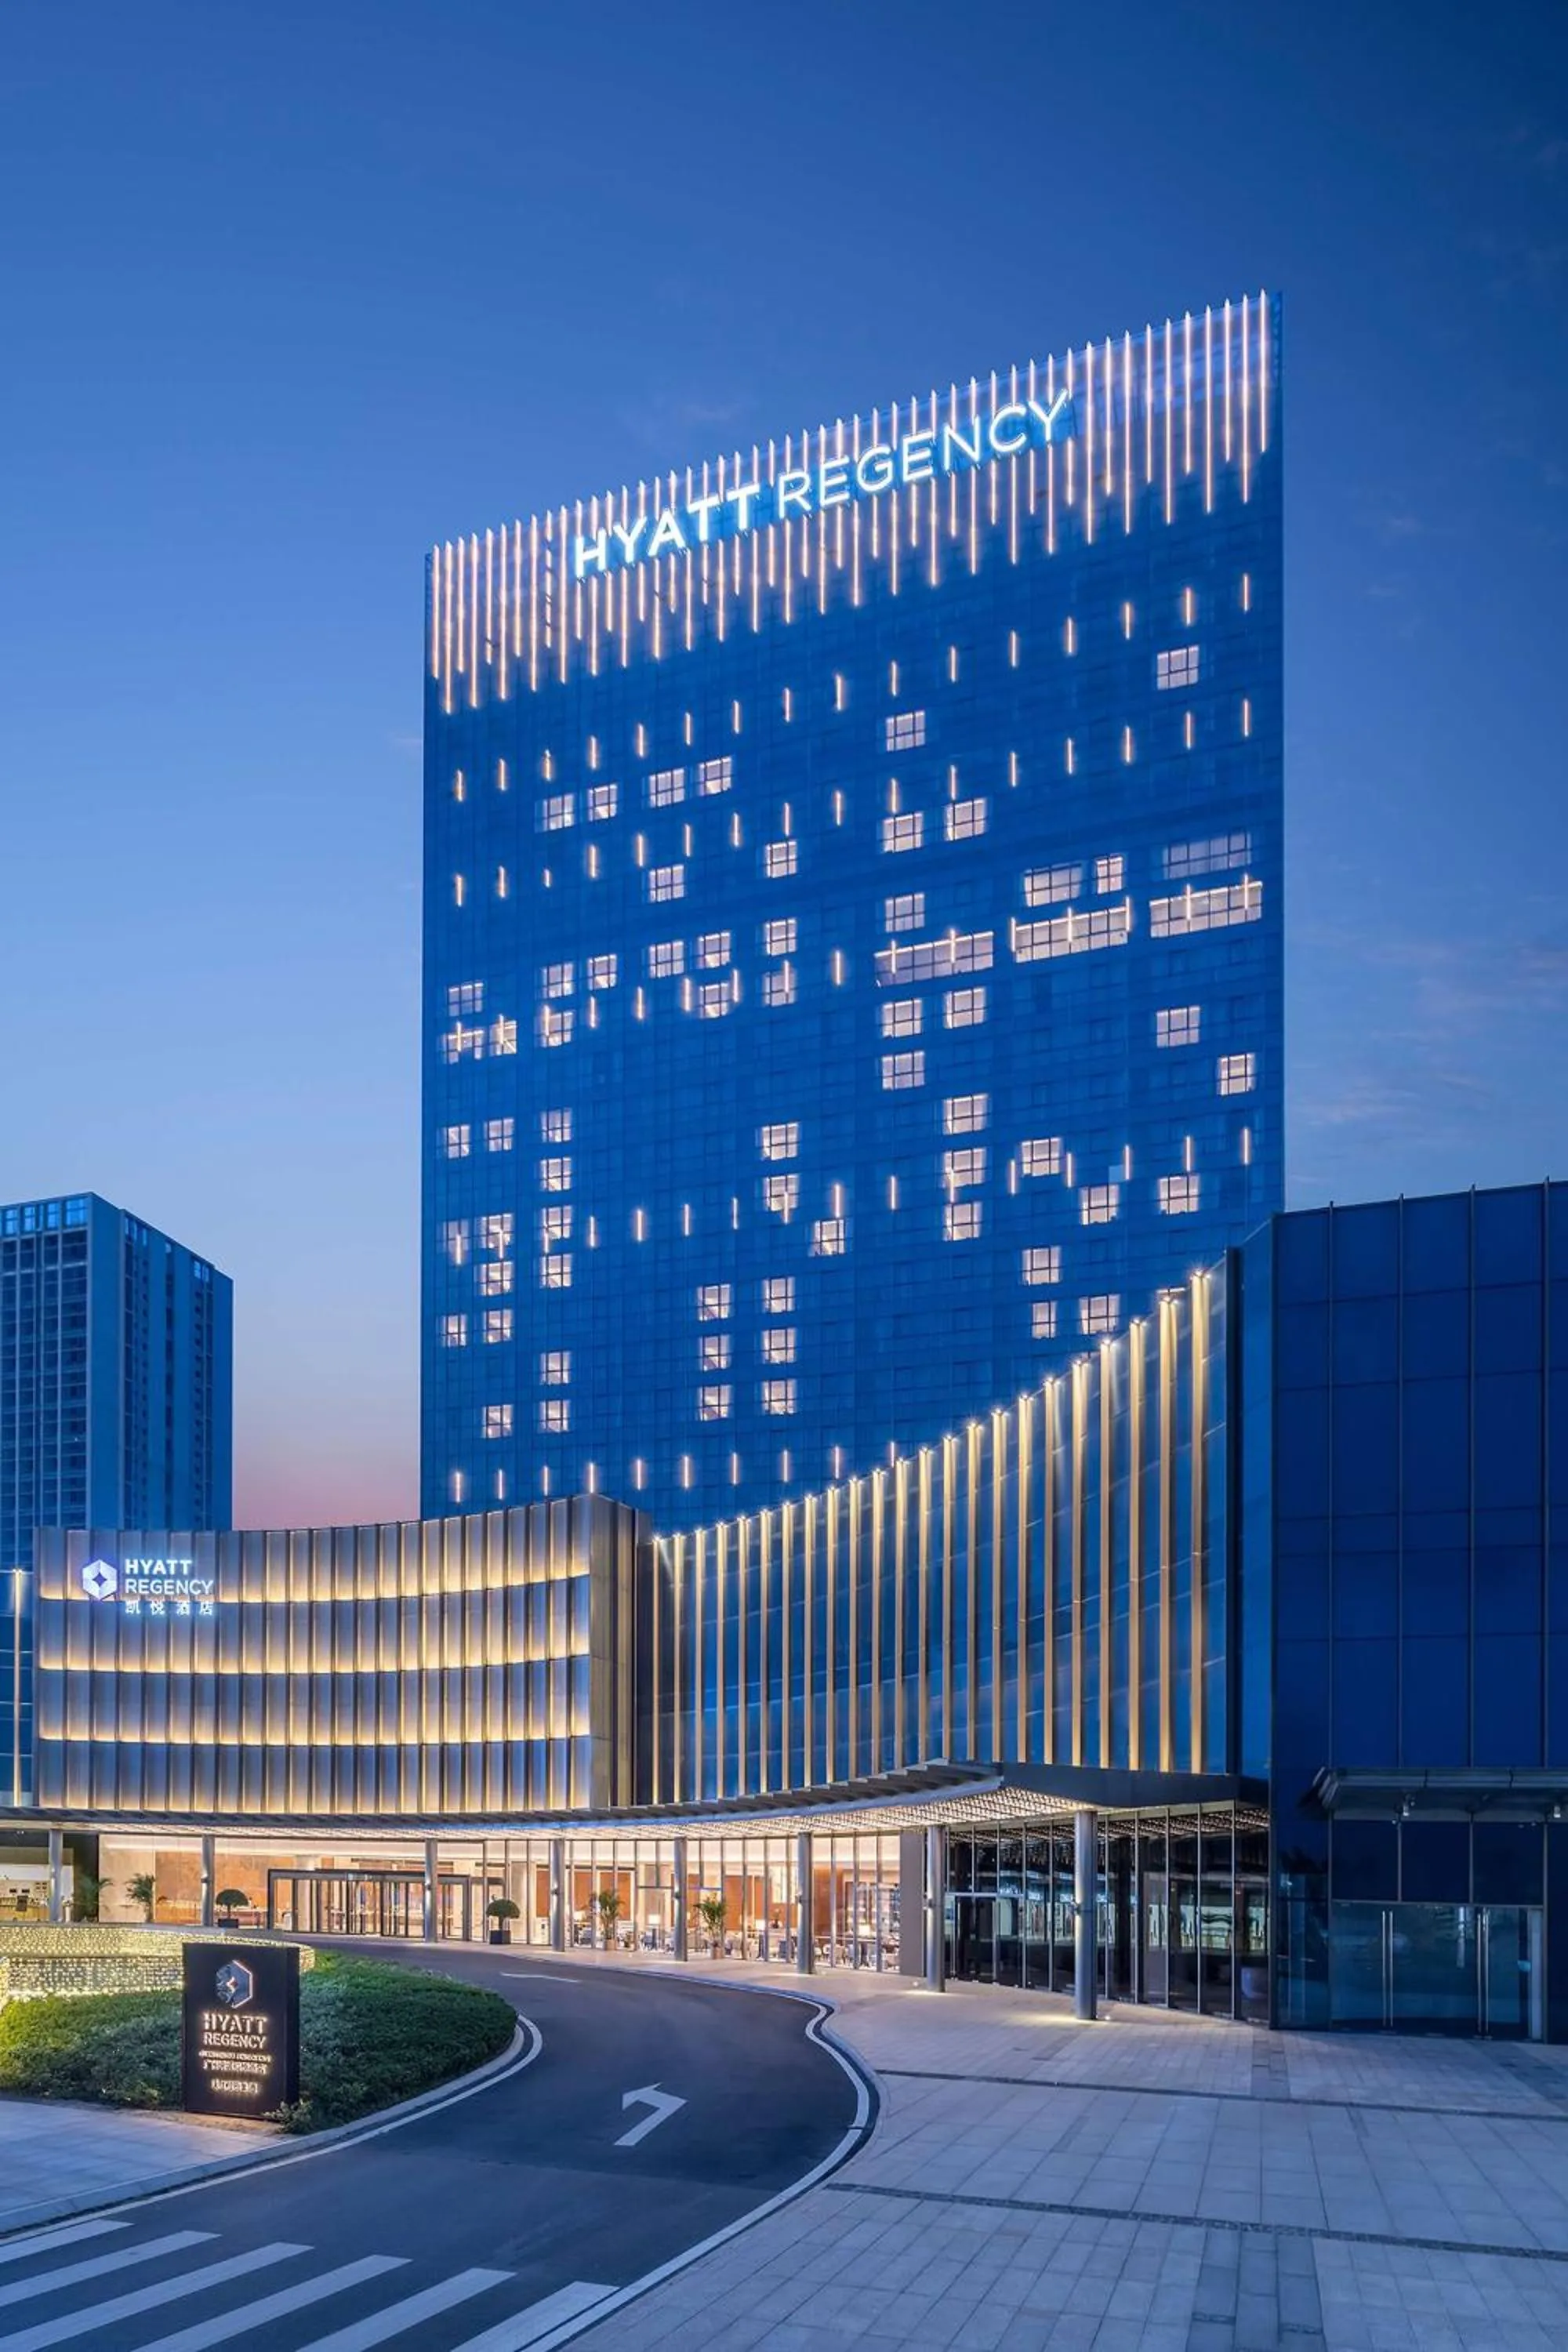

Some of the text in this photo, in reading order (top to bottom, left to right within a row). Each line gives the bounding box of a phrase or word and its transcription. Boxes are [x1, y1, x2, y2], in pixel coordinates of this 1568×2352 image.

[574, 388, 1071, 579] HYATT REGENCY
[125, 1559, 192, 1575] HYATT
[125, 1578, 214, 1595] REGENCY
[125, 1599, 214, 1617] 凯悦酒店
[203, 2012, 268, 2034] HYATT
[203, 2031, 267, 2049] REGENCY
